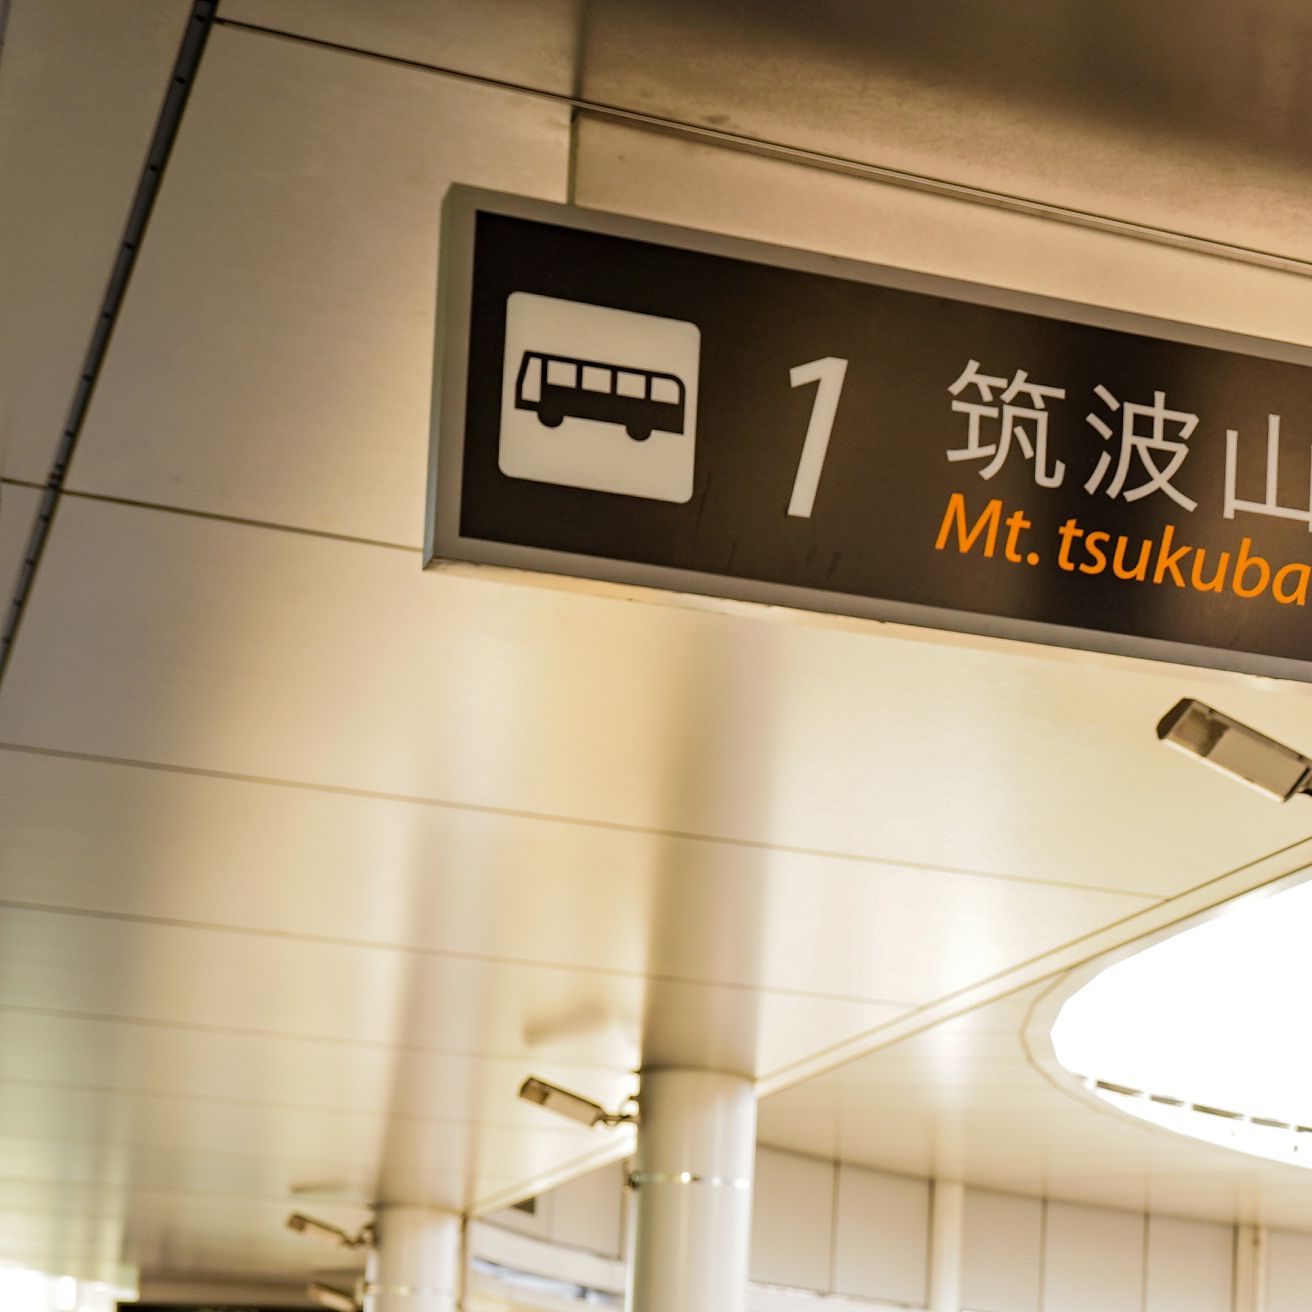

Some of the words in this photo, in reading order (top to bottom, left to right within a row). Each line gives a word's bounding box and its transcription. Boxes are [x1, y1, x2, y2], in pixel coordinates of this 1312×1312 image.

[786, 357, 849, 518] 1
[935, 493, 1042, 568] Mt.
[1056, 514, 1312, 607] tsukuba
